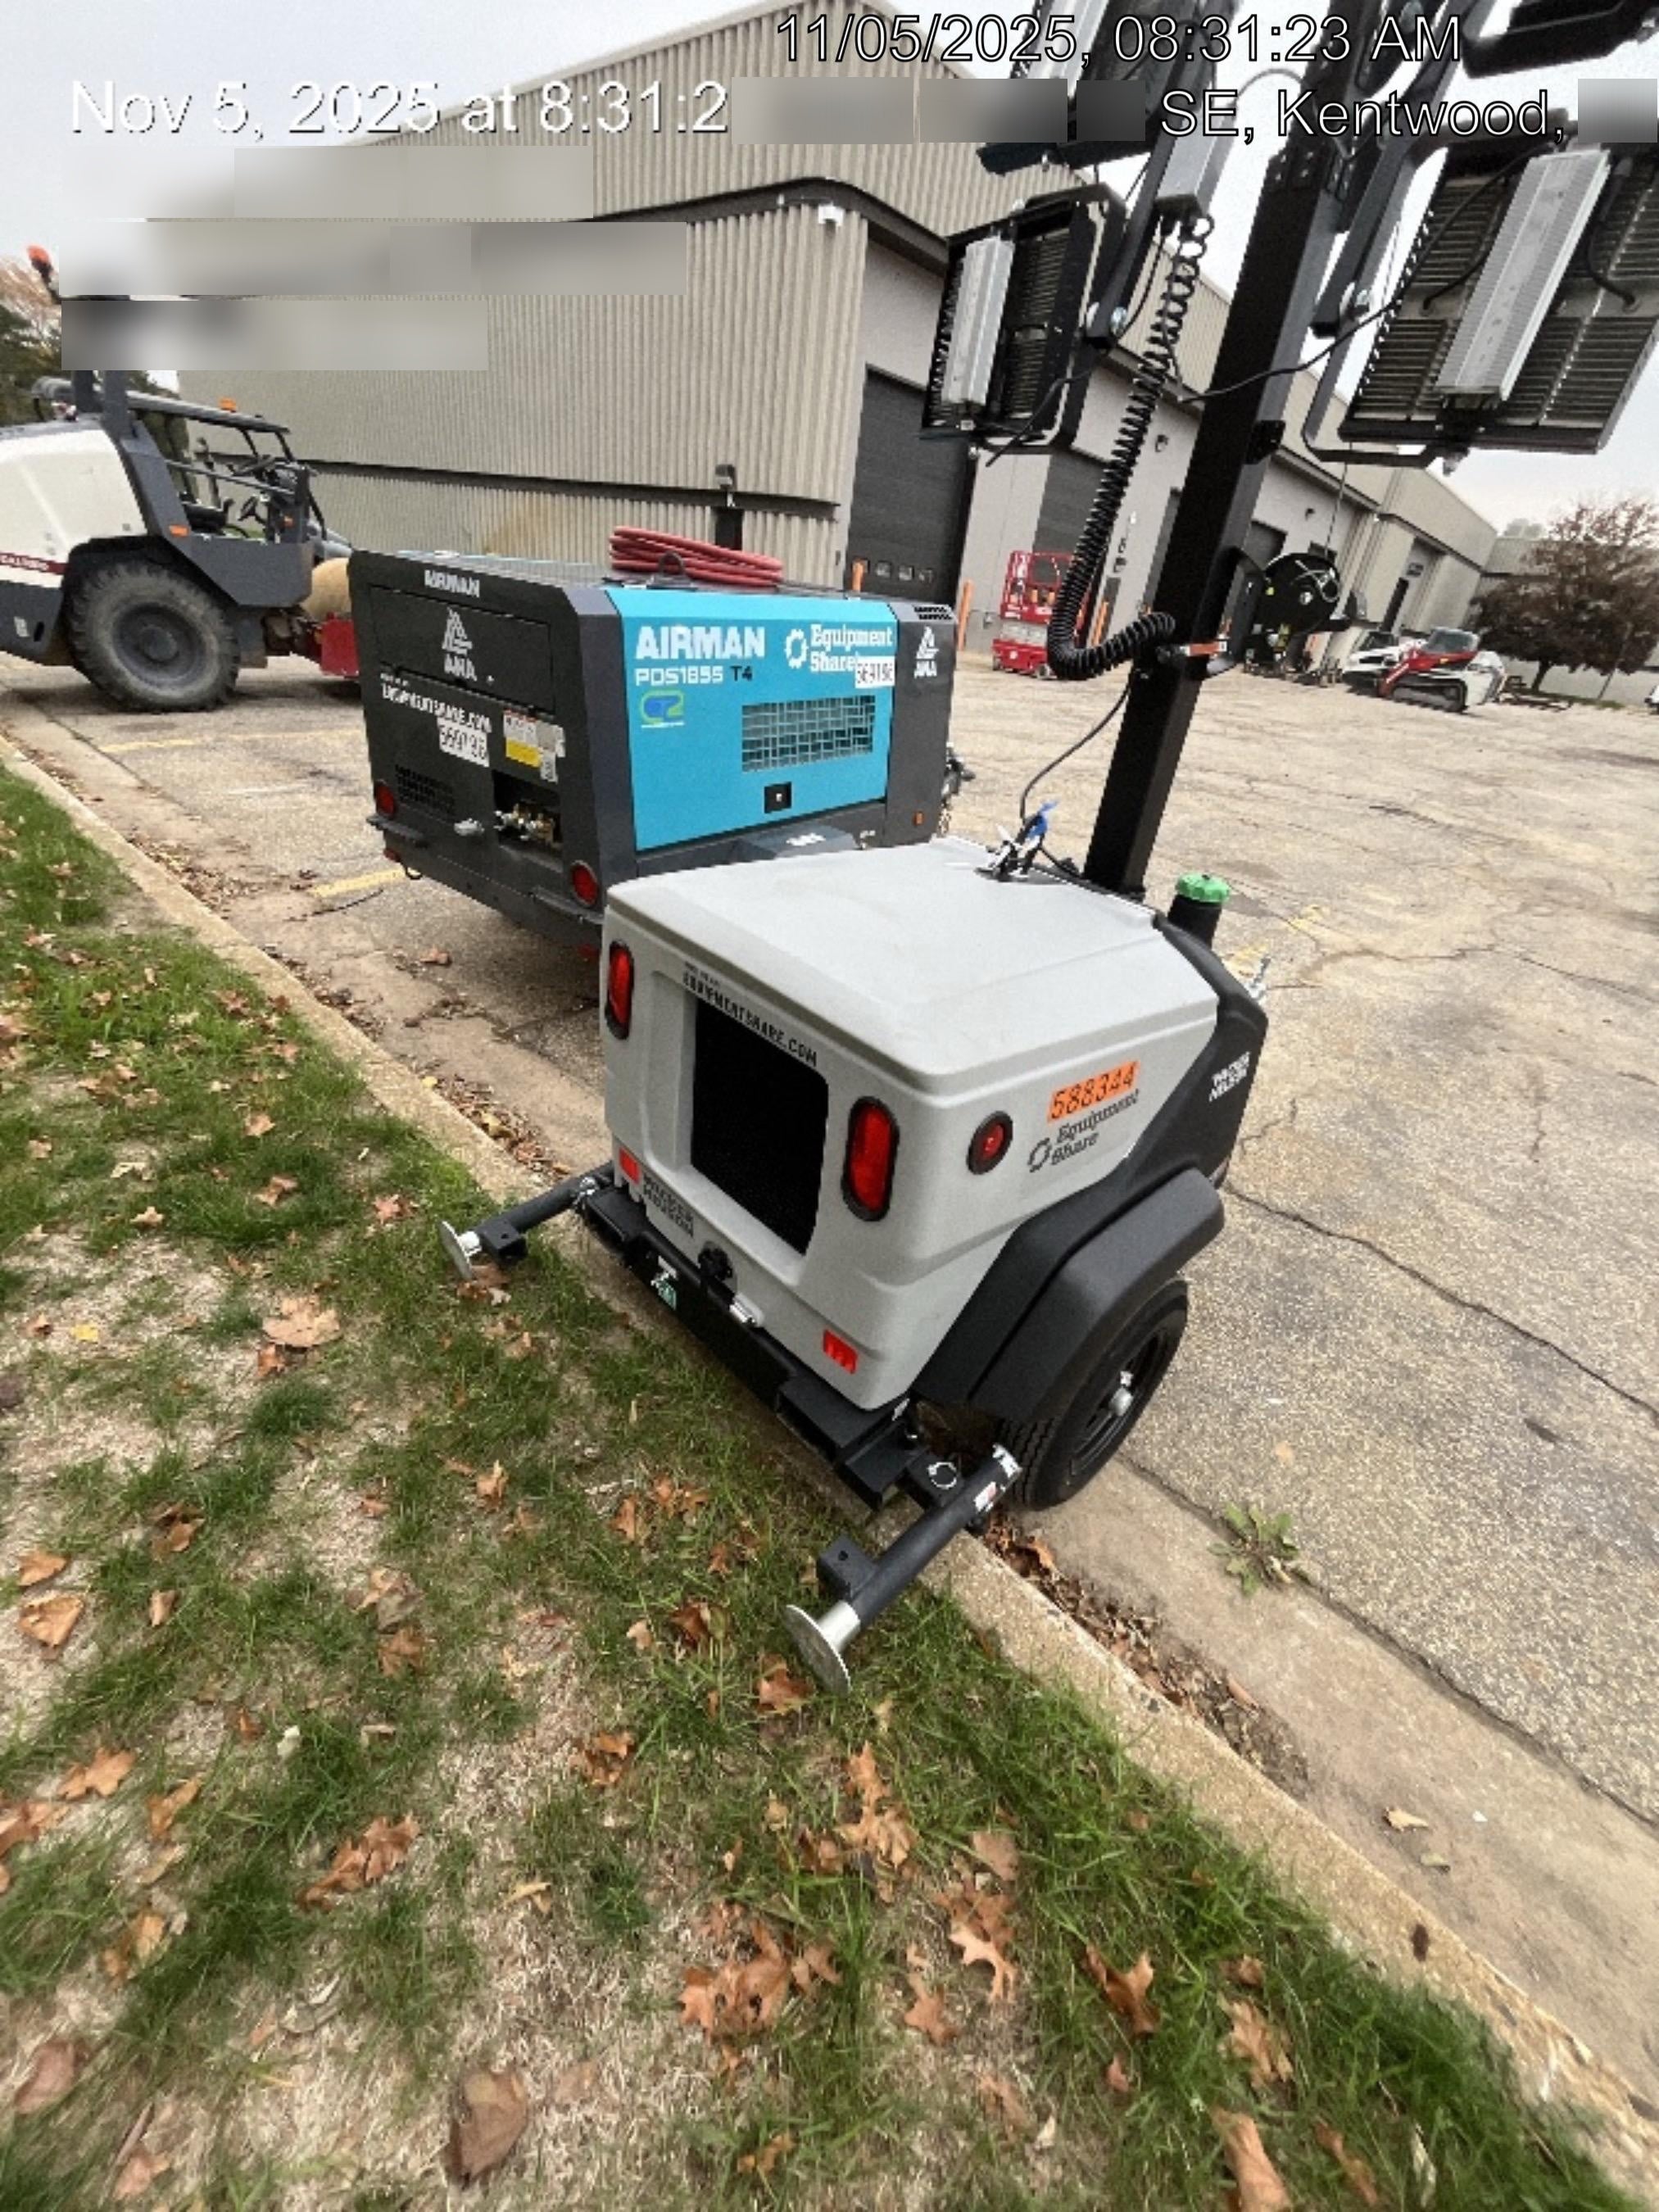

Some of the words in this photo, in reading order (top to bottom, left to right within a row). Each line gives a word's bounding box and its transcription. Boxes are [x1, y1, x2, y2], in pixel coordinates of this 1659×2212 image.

[636, 626, 766, 660] AIRMAN
[810, 623, 893, 651] Equipment
[635, 666, 723, 687] PDS185S
[730, 665, 753, 682] T4
[810, 651, 856, 672] Share
[1051, 1062, 1137, 1120] 588344
[1056, 1088, 1140, 1144] Equipment
[1050, 1132, 1099, 1165] Share
